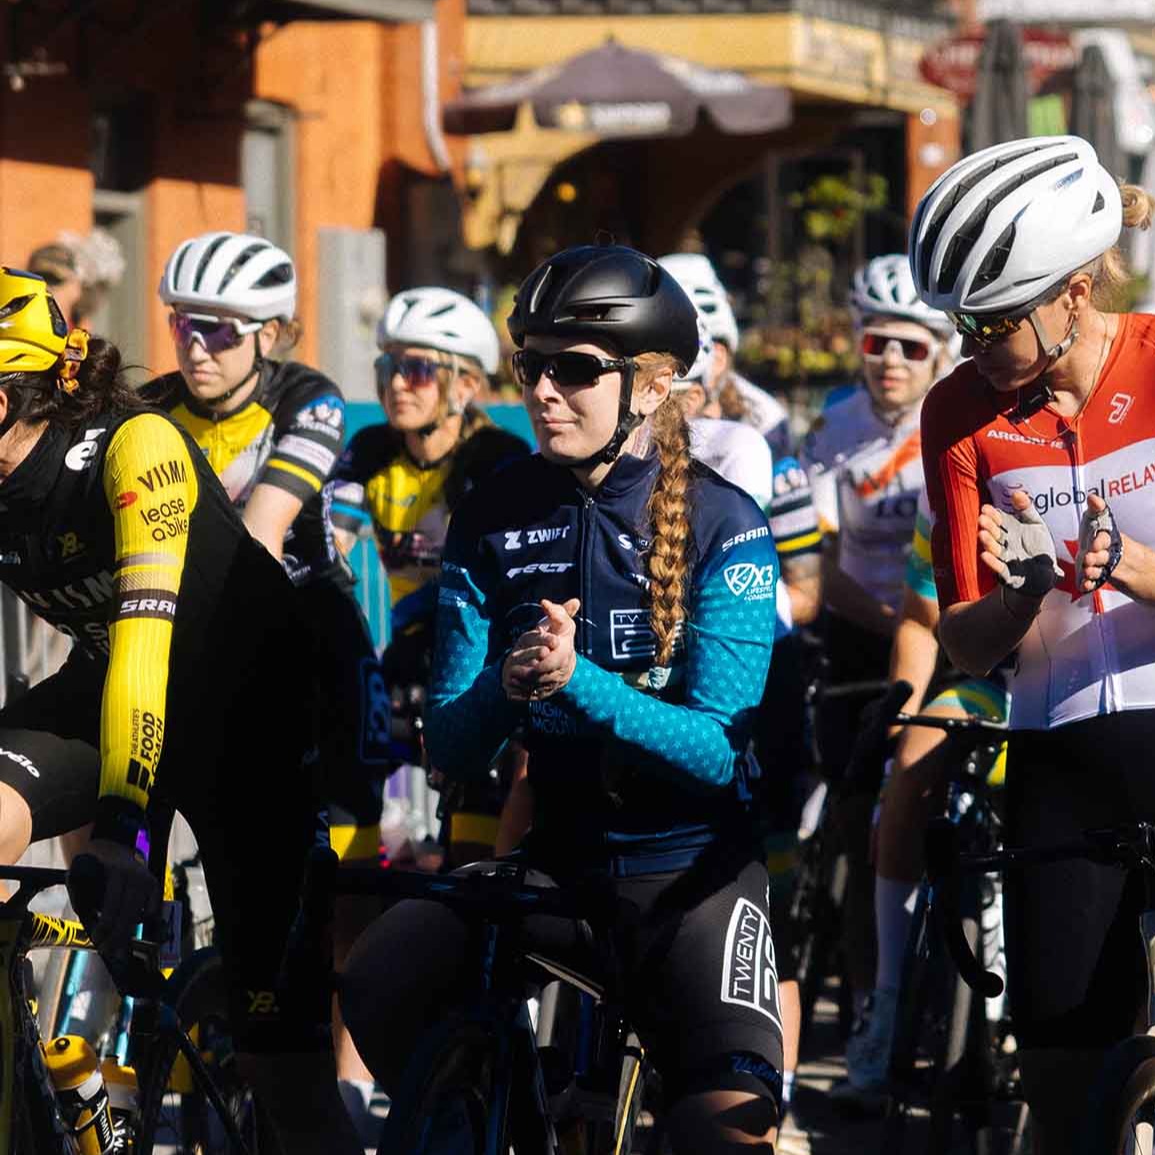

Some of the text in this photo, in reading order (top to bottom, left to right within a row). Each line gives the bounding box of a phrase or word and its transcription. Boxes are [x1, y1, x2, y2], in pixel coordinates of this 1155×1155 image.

[137, 460, 188, 492] VISMA
[140, 498, 186, 526] lease
[527, 525, 570, 544] ZWIFT
[722, 526, 769, 553] SRAM
[506, 562, 576, 579] FELT
[140, 711, 155, 762] FOOD
[732, 906, 759, 997] TWENTY
